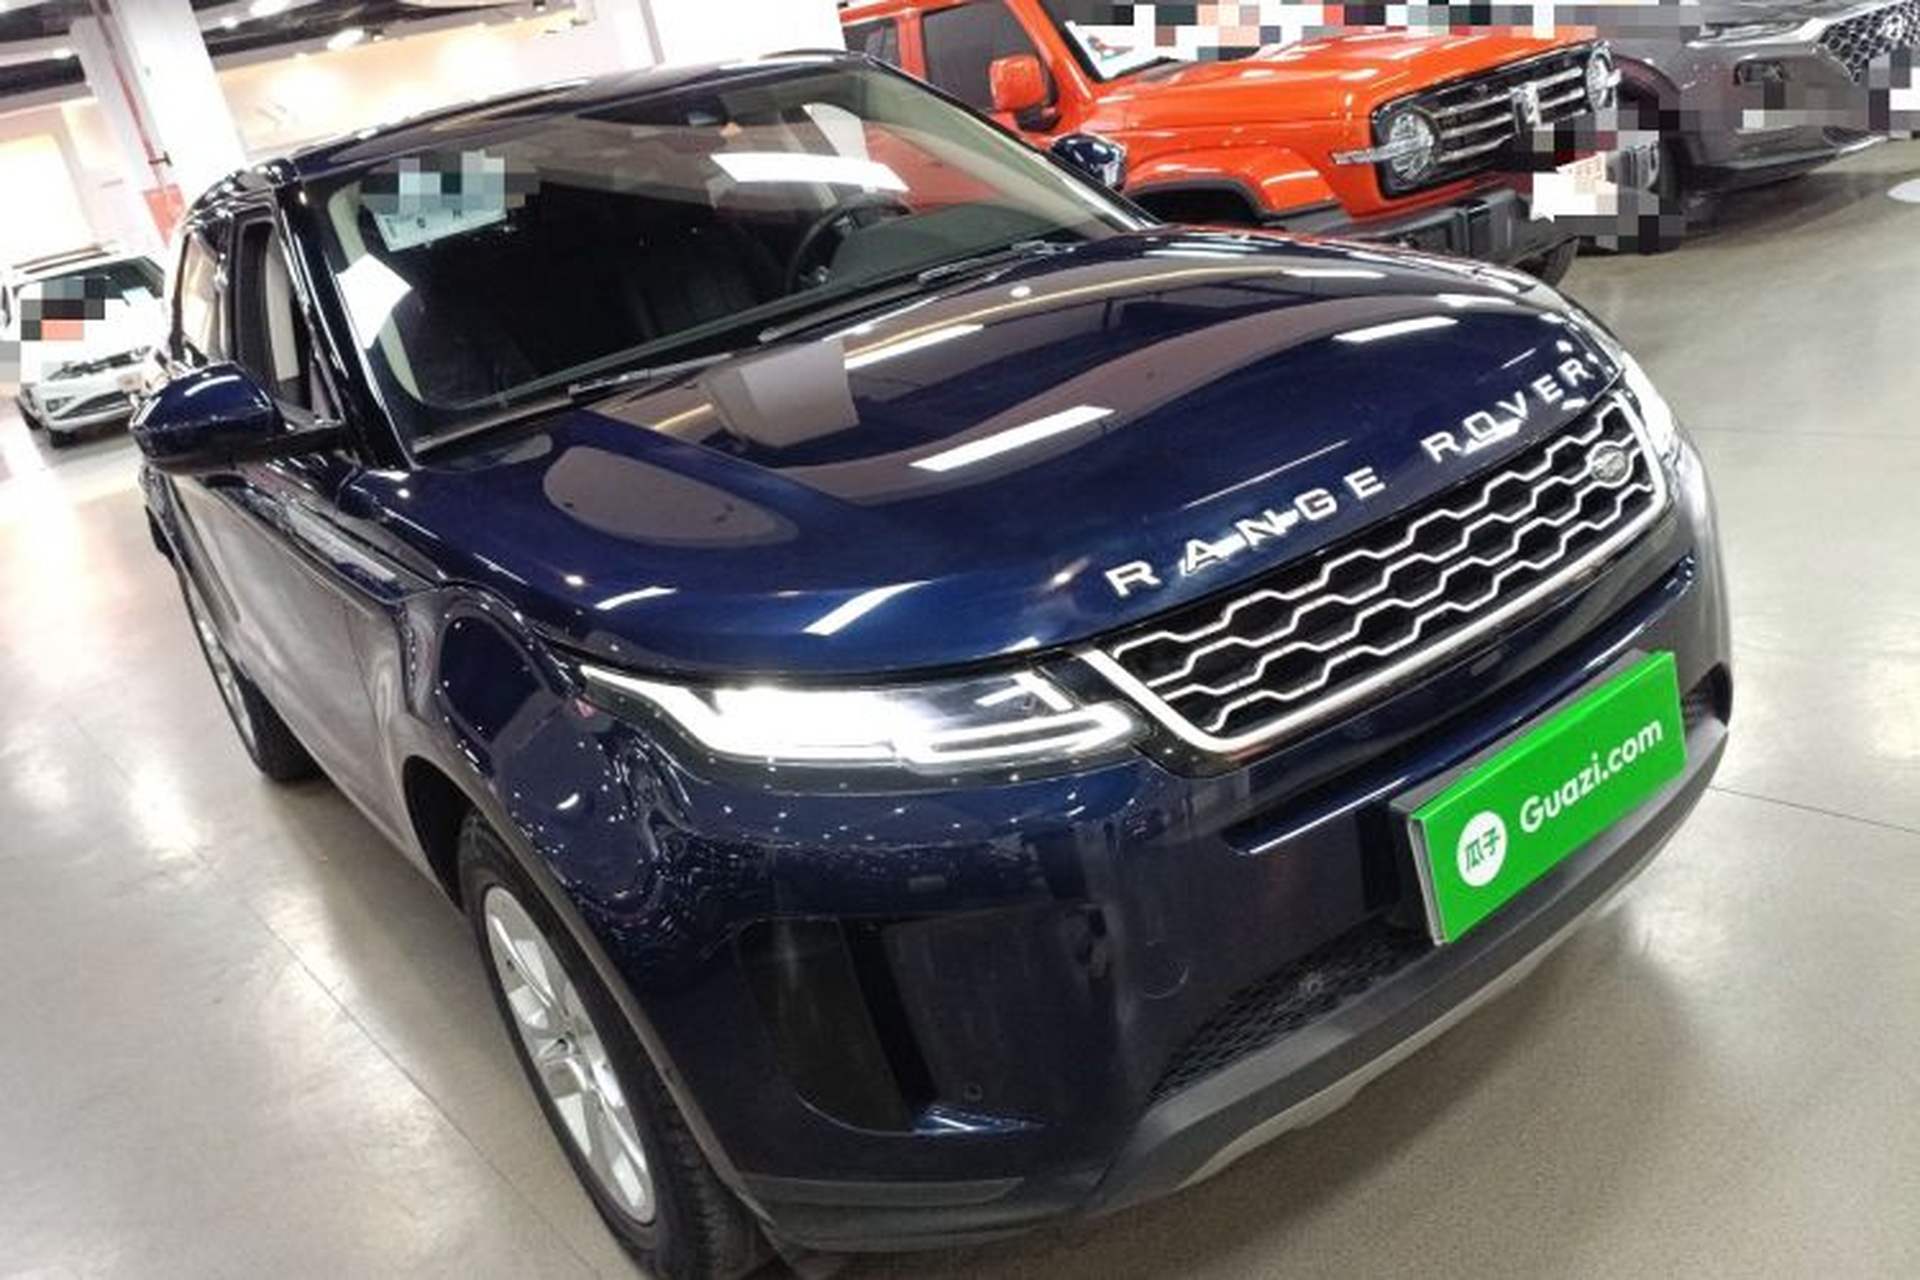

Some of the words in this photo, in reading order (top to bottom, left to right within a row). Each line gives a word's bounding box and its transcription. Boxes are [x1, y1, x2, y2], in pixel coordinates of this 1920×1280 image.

[1105, 466, 1386, 597] RANGE
[1420, 358, 1595, 463] ROVER
[1519, 720, 1663, 833] Guazi.com
[1465, 827, 1501, 872] 瓜子
